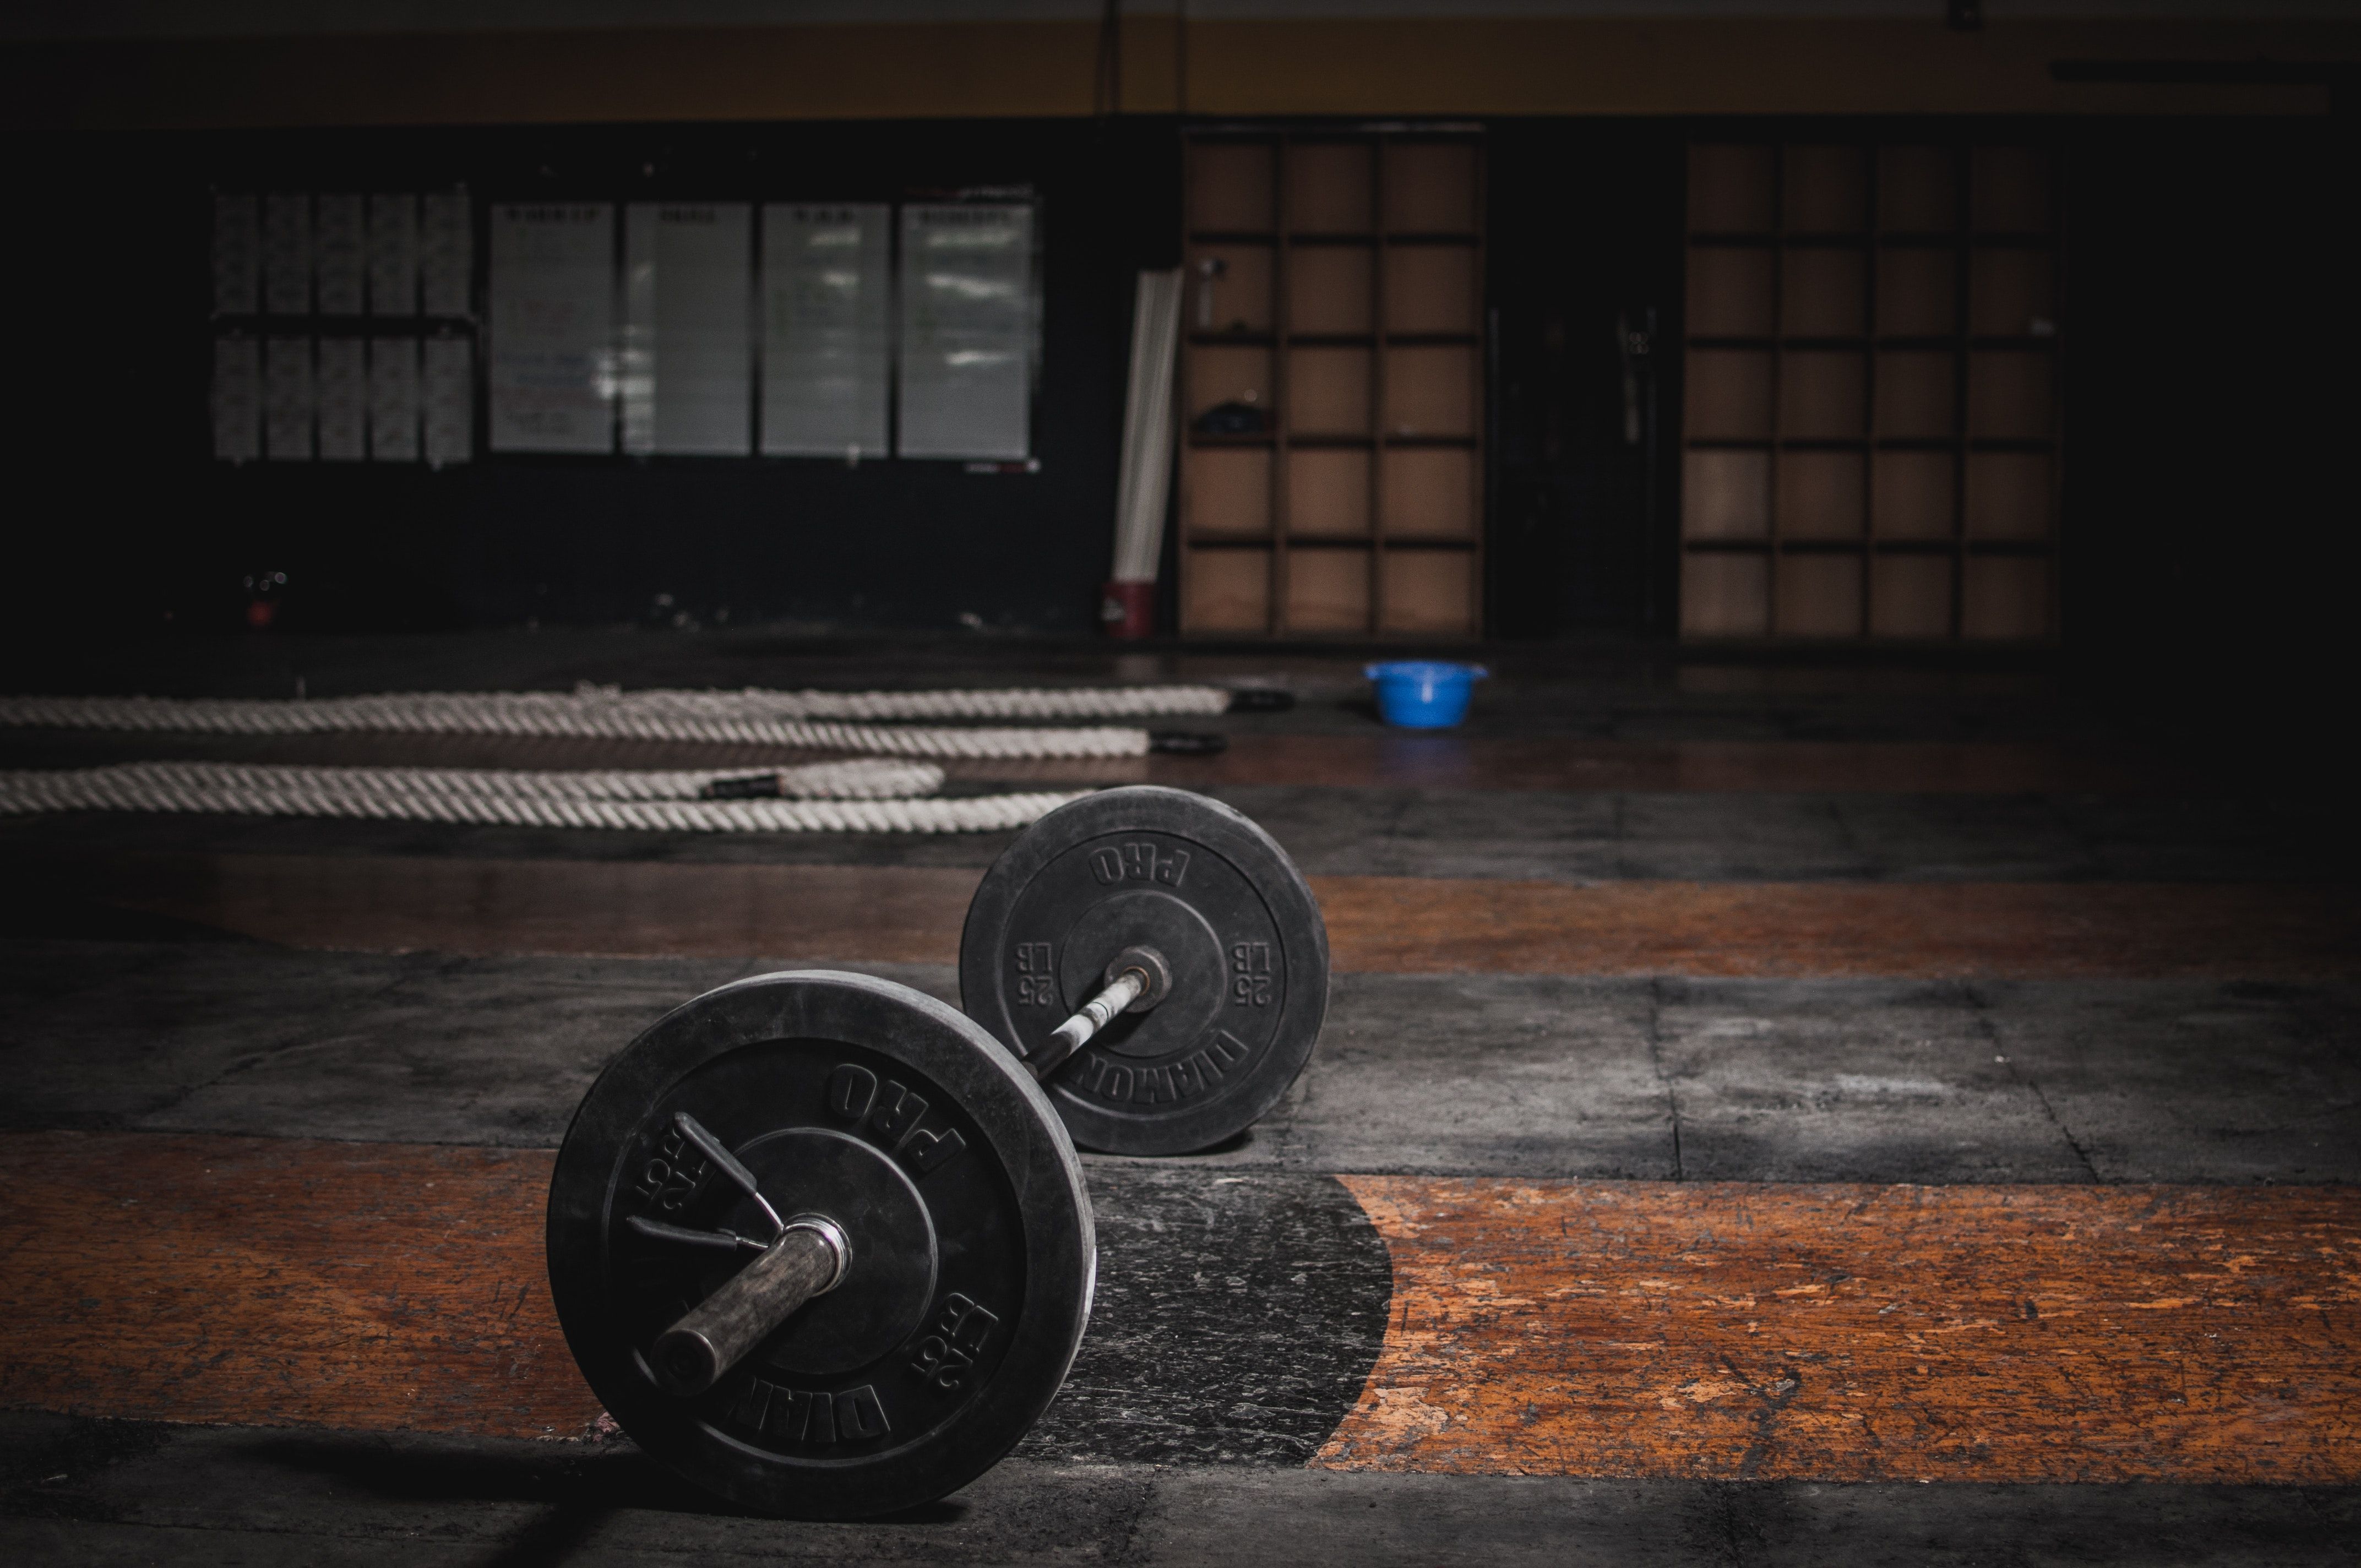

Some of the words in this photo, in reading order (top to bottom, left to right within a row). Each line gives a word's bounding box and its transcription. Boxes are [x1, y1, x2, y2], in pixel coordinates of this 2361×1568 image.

[1089, 842, 1192, 888] PRO
[1016, 942, 1052, 973] LB
[1233, 942, 1270, 973] LB
[1017, 974, 1053, 1006] 25
[1234, 974, 1272, 1007] 25
[1066, 1028, 1249, 1104] DIAMON
[829, 1063, 967, 1173] PRO
[634, 1158, 696, 1210] 25
[939, 1292, 999, 1354] LB
[909, 1335, 973, 1387] 25
